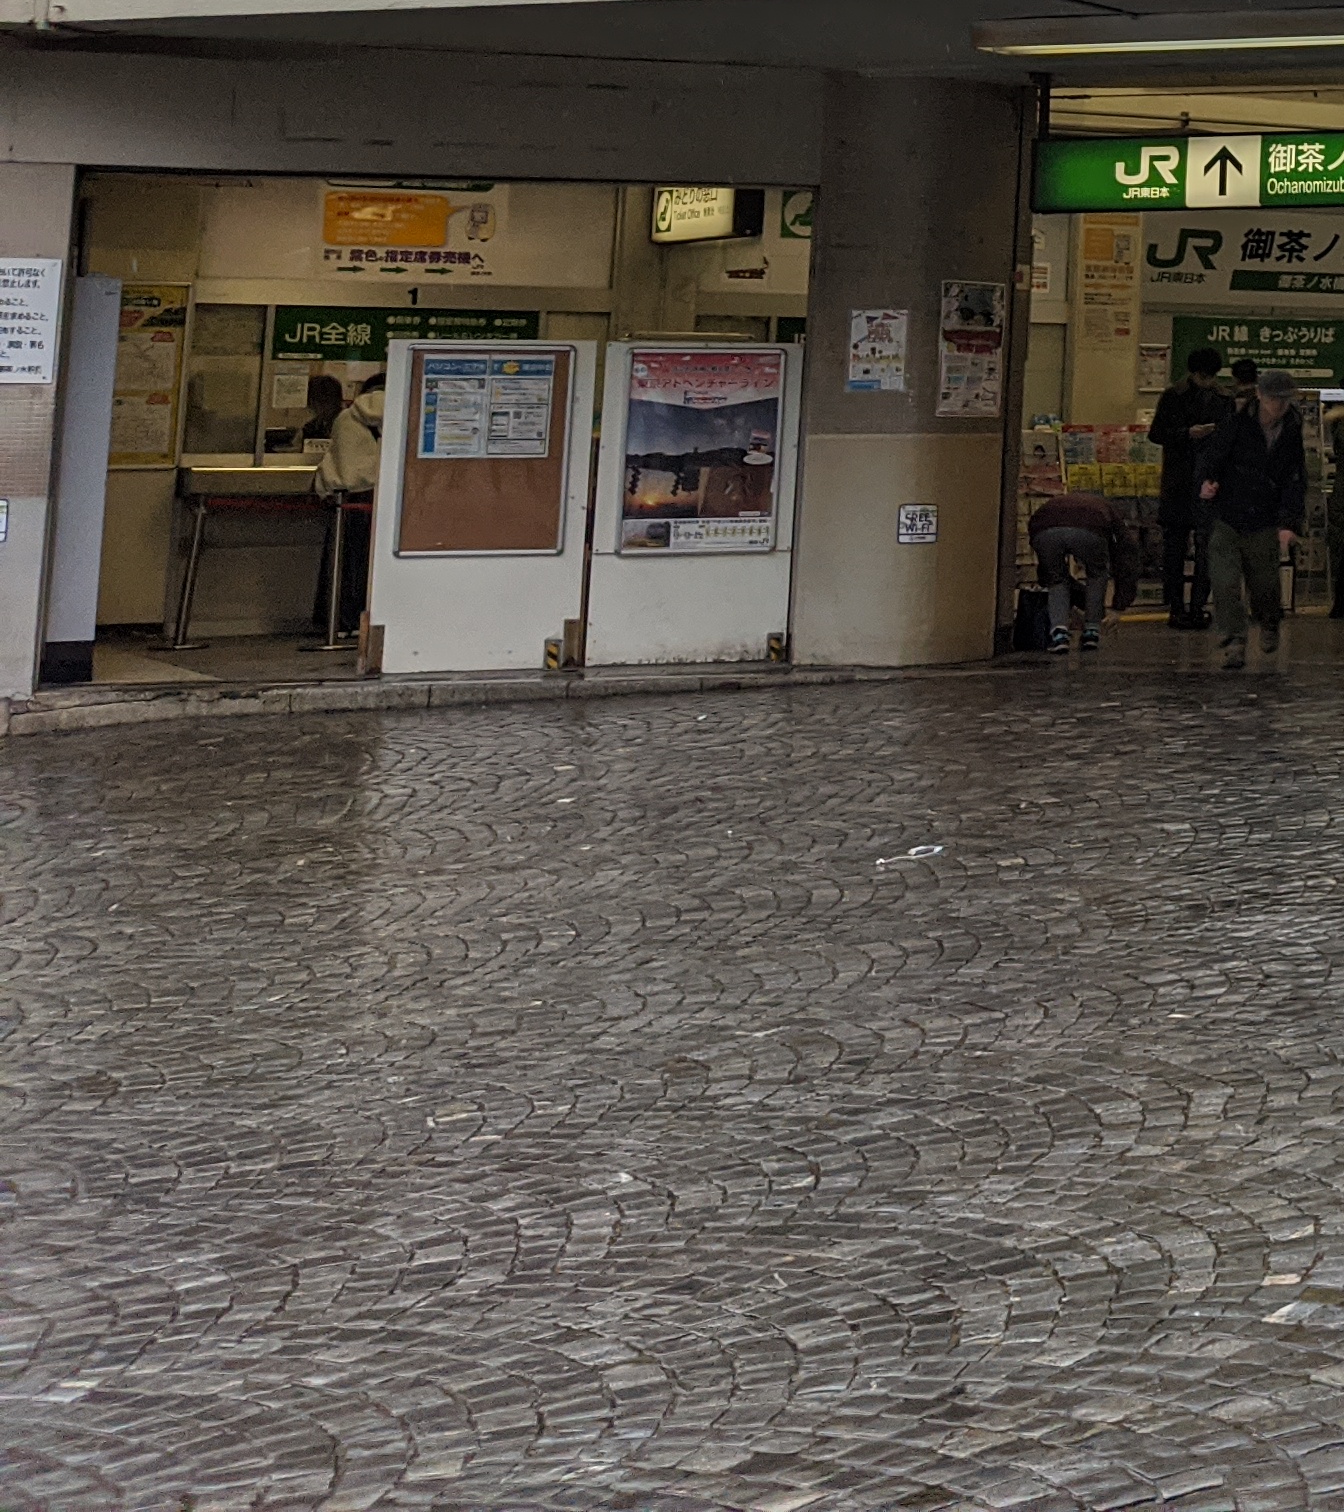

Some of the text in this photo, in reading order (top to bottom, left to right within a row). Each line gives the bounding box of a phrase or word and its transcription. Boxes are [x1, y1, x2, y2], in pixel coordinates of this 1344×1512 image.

[1115, 146, 1180, 185] JR
[1122, 186, 1171, 199] JR東日本
[1146, 228, 1223, 270] JR
[407, 287, 418, 306] 1
[285, 322, 371, 346] JR全線
[1259, 325, 1336, 343] きっぷうりば
